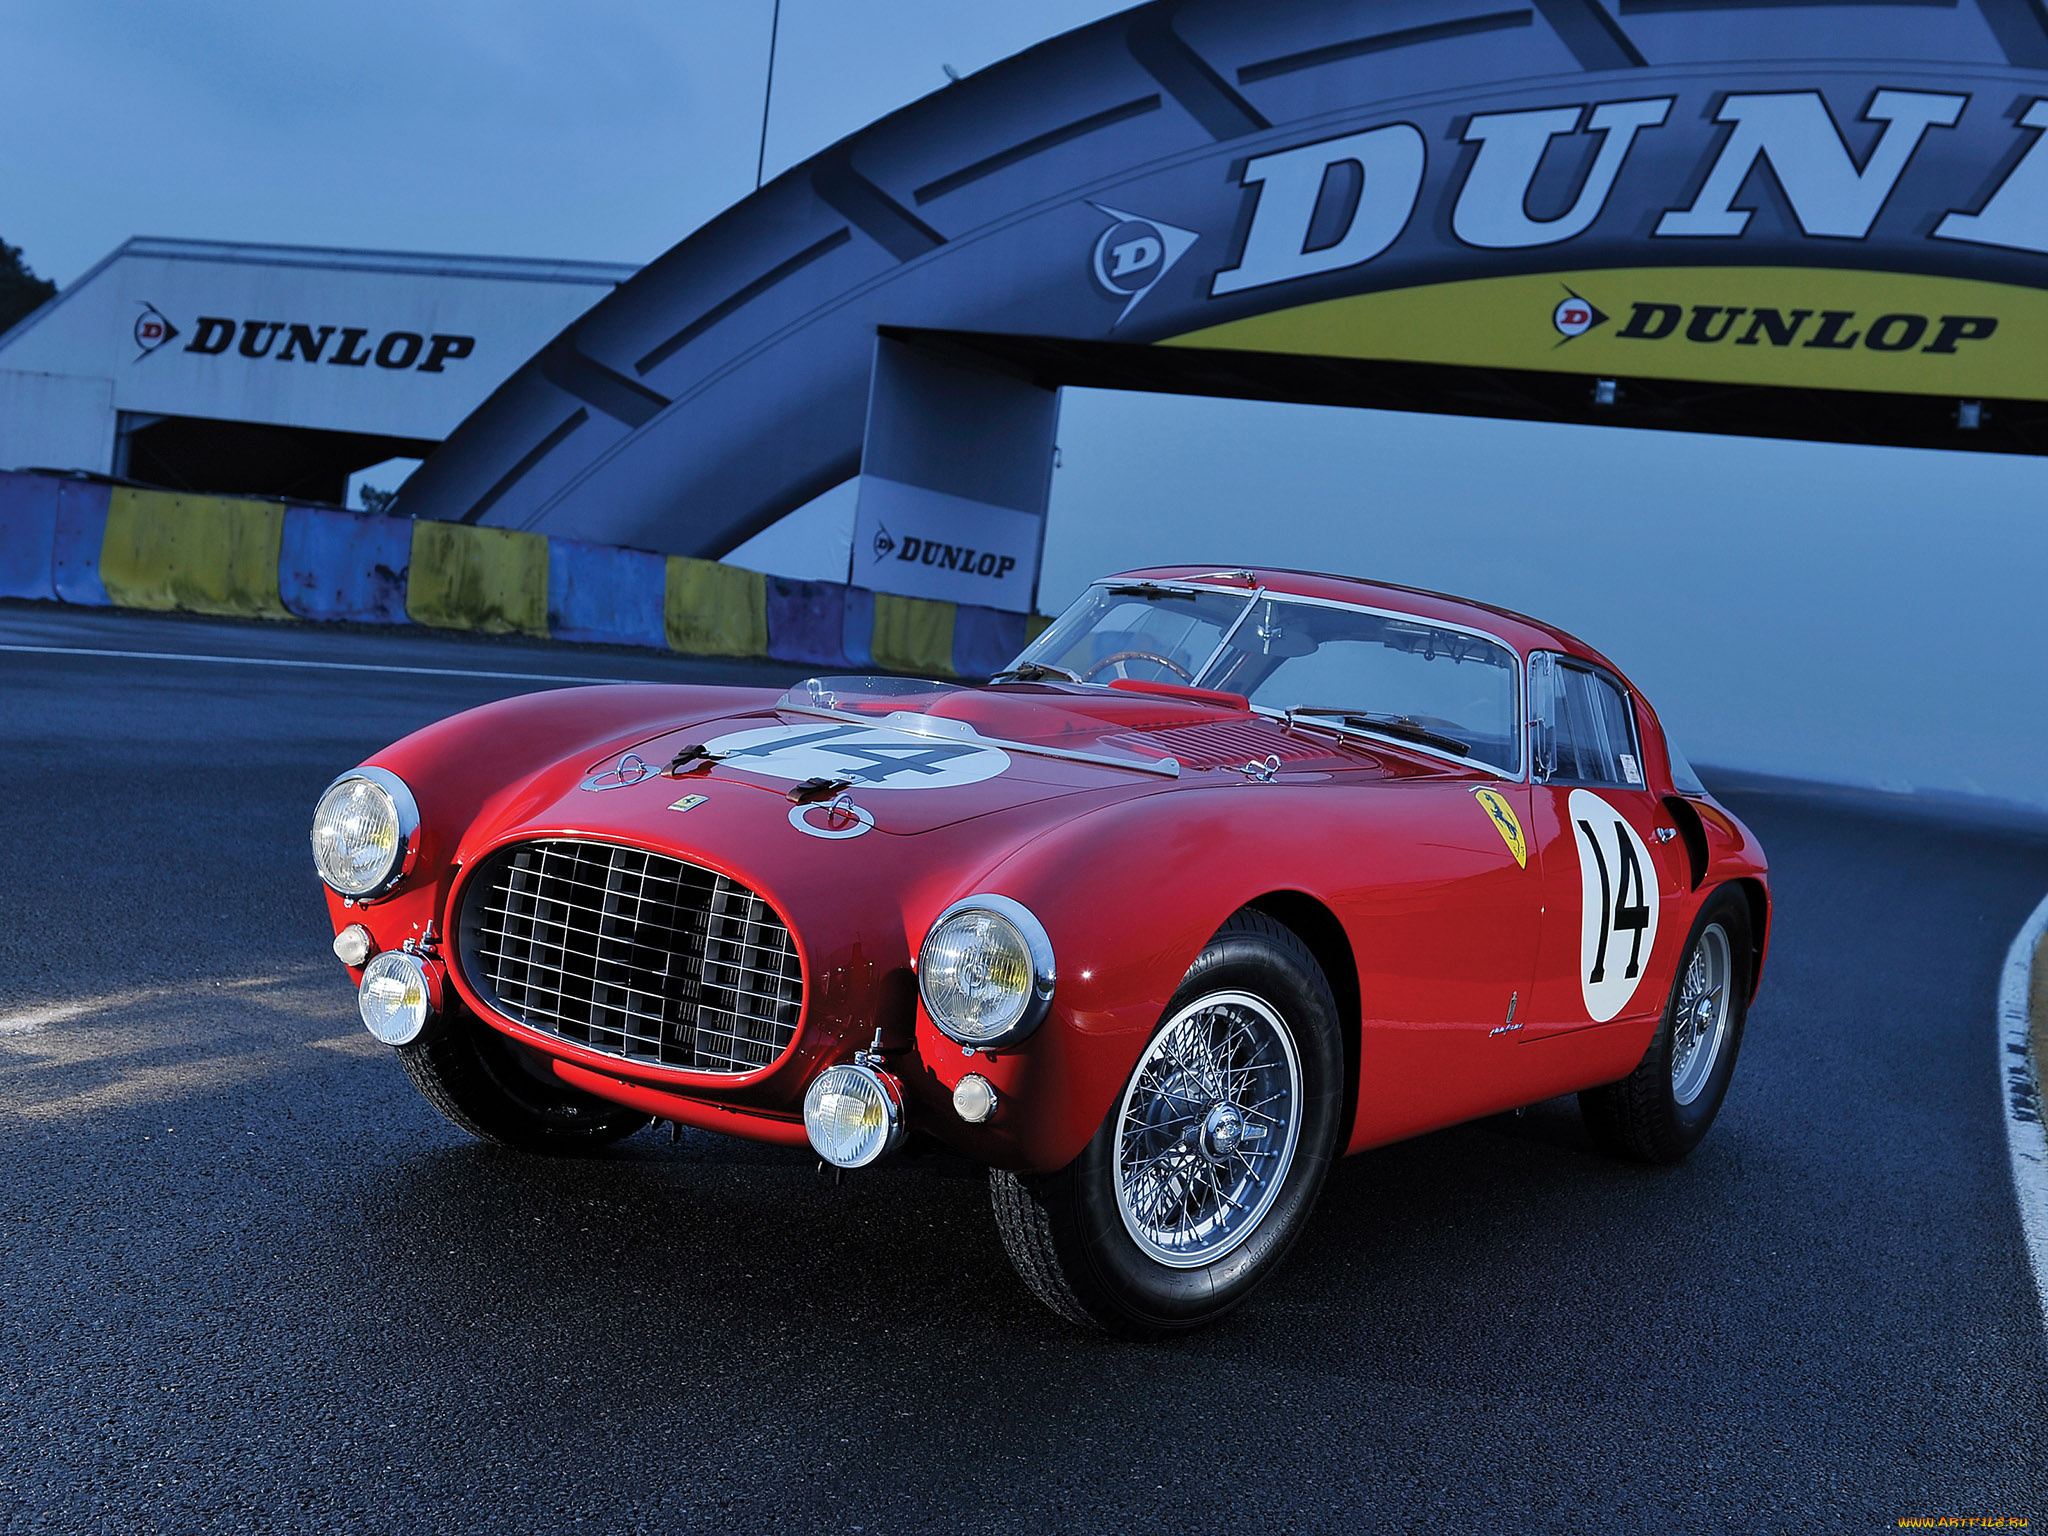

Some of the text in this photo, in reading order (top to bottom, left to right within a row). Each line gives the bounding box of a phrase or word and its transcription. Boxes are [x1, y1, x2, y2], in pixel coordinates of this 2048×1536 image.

[184, 316, 476, 373] DUNLOP
[1613, 300, 2000, 355] DUNLOP
[897, 535, 1016, 579] DUNLOP
[733, 724, 990, 783] 14
[1576, 819, 1650, 984] 14
